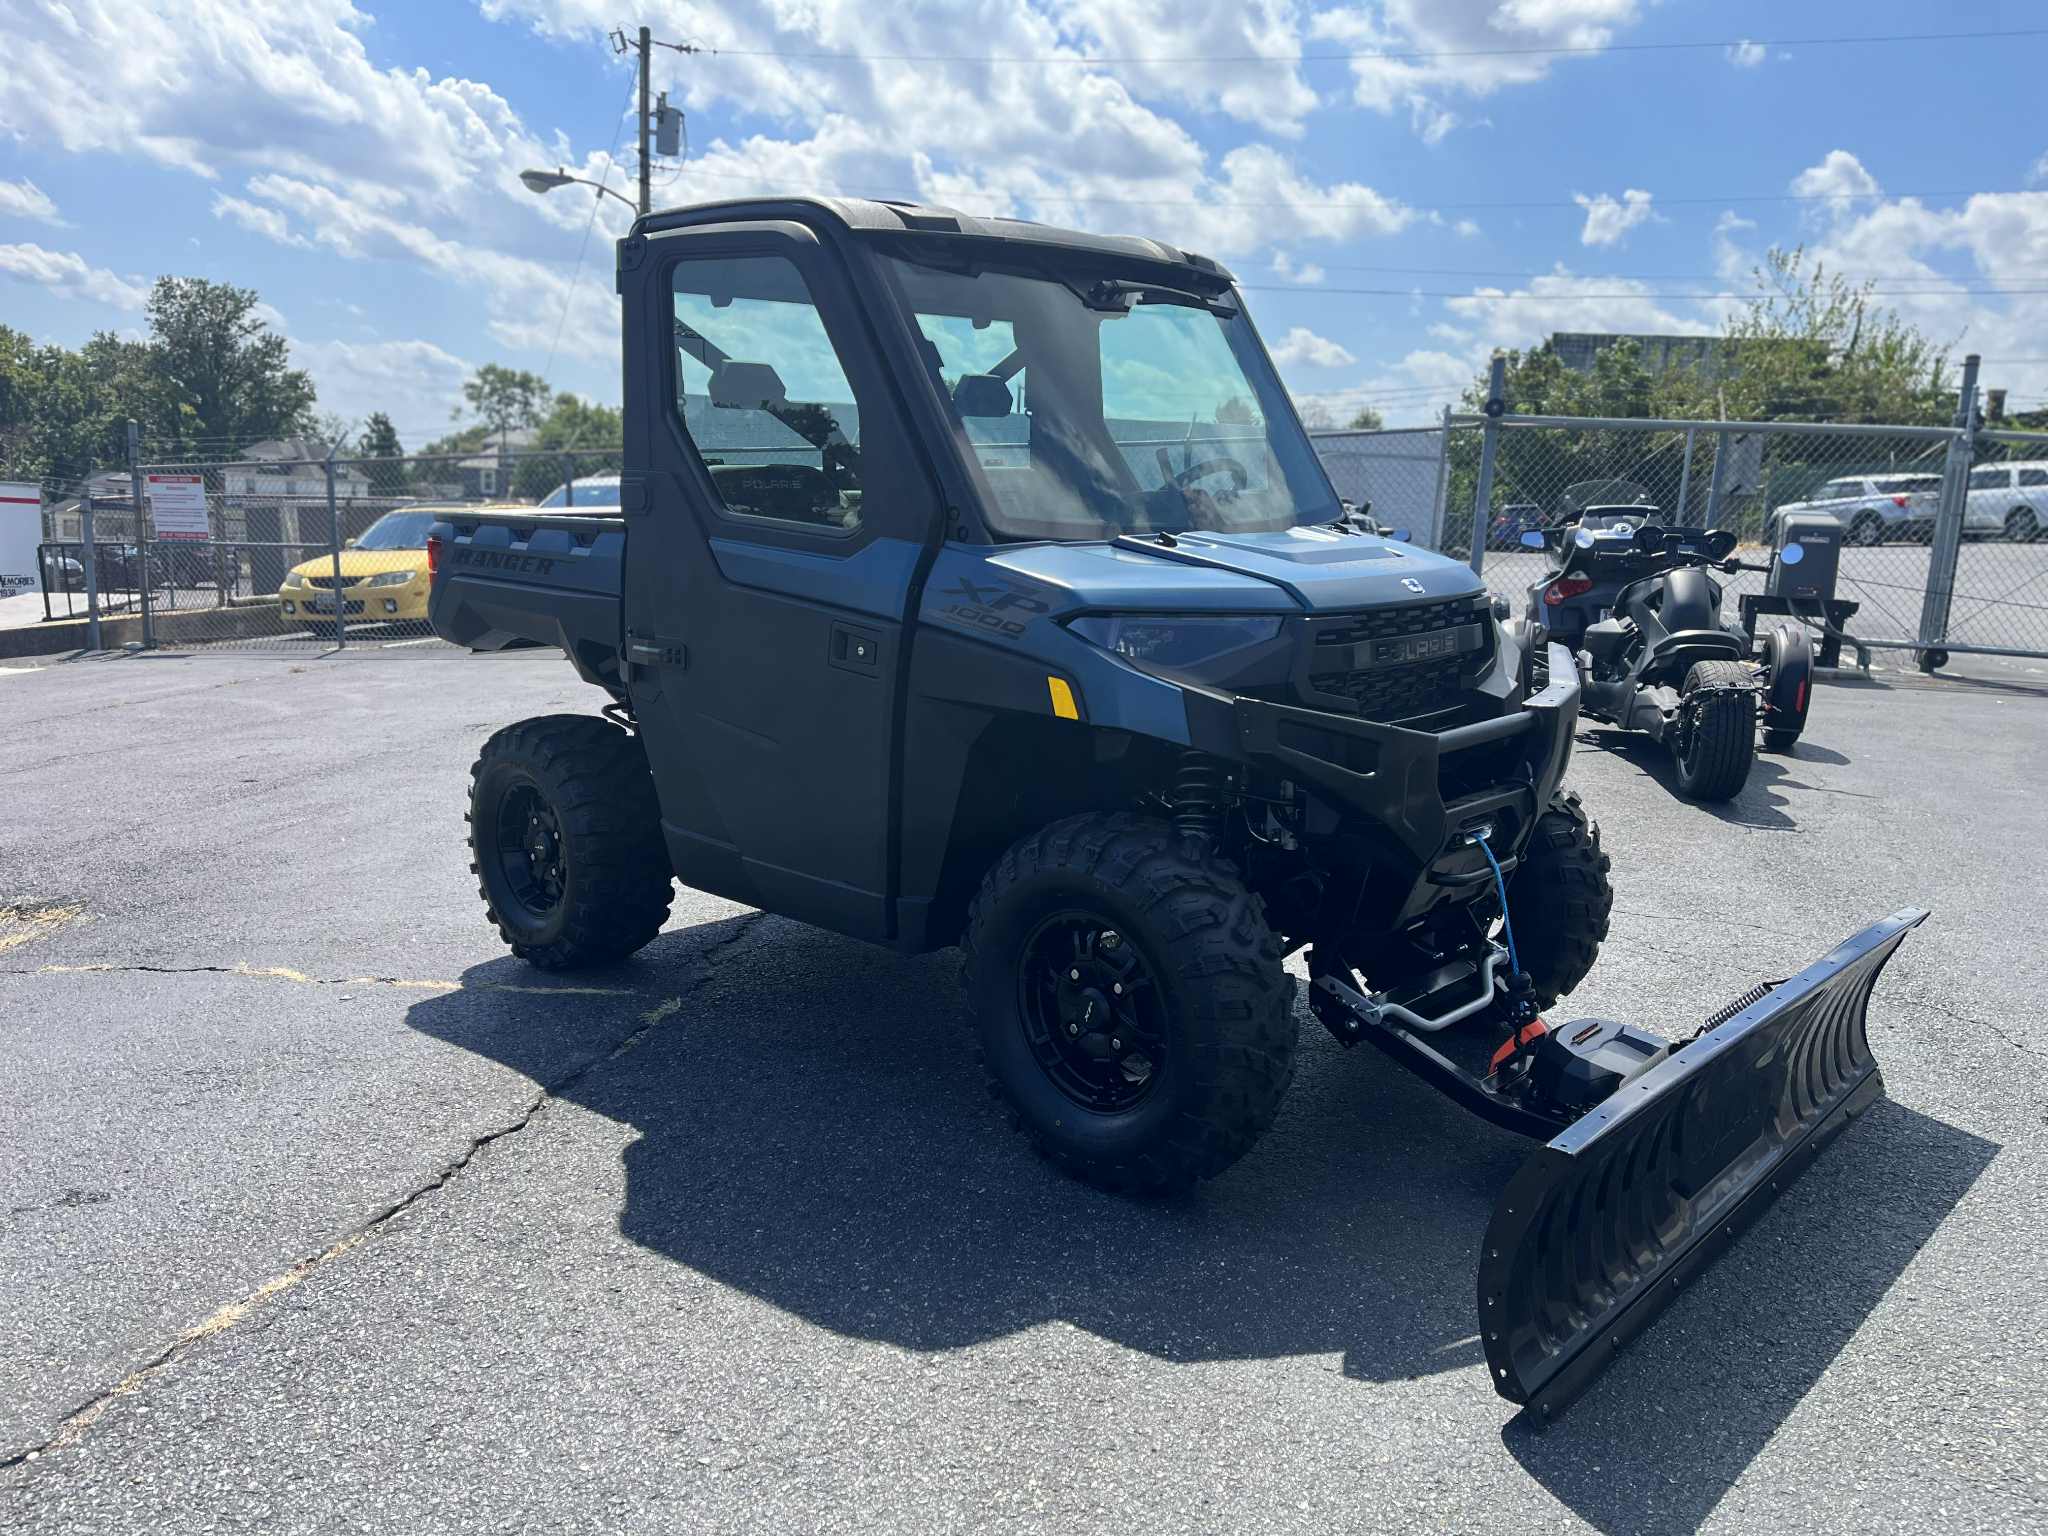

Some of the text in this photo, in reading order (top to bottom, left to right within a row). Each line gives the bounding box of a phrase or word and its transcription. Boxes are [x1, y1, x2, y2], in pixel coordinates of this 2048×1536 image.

[453, 549, 554, 576] RANGER
[942, 576, 1049, 614] XP
[944, 603, 1026, 633] 1000
[1377, 635, 1455, 662] POLARIS
